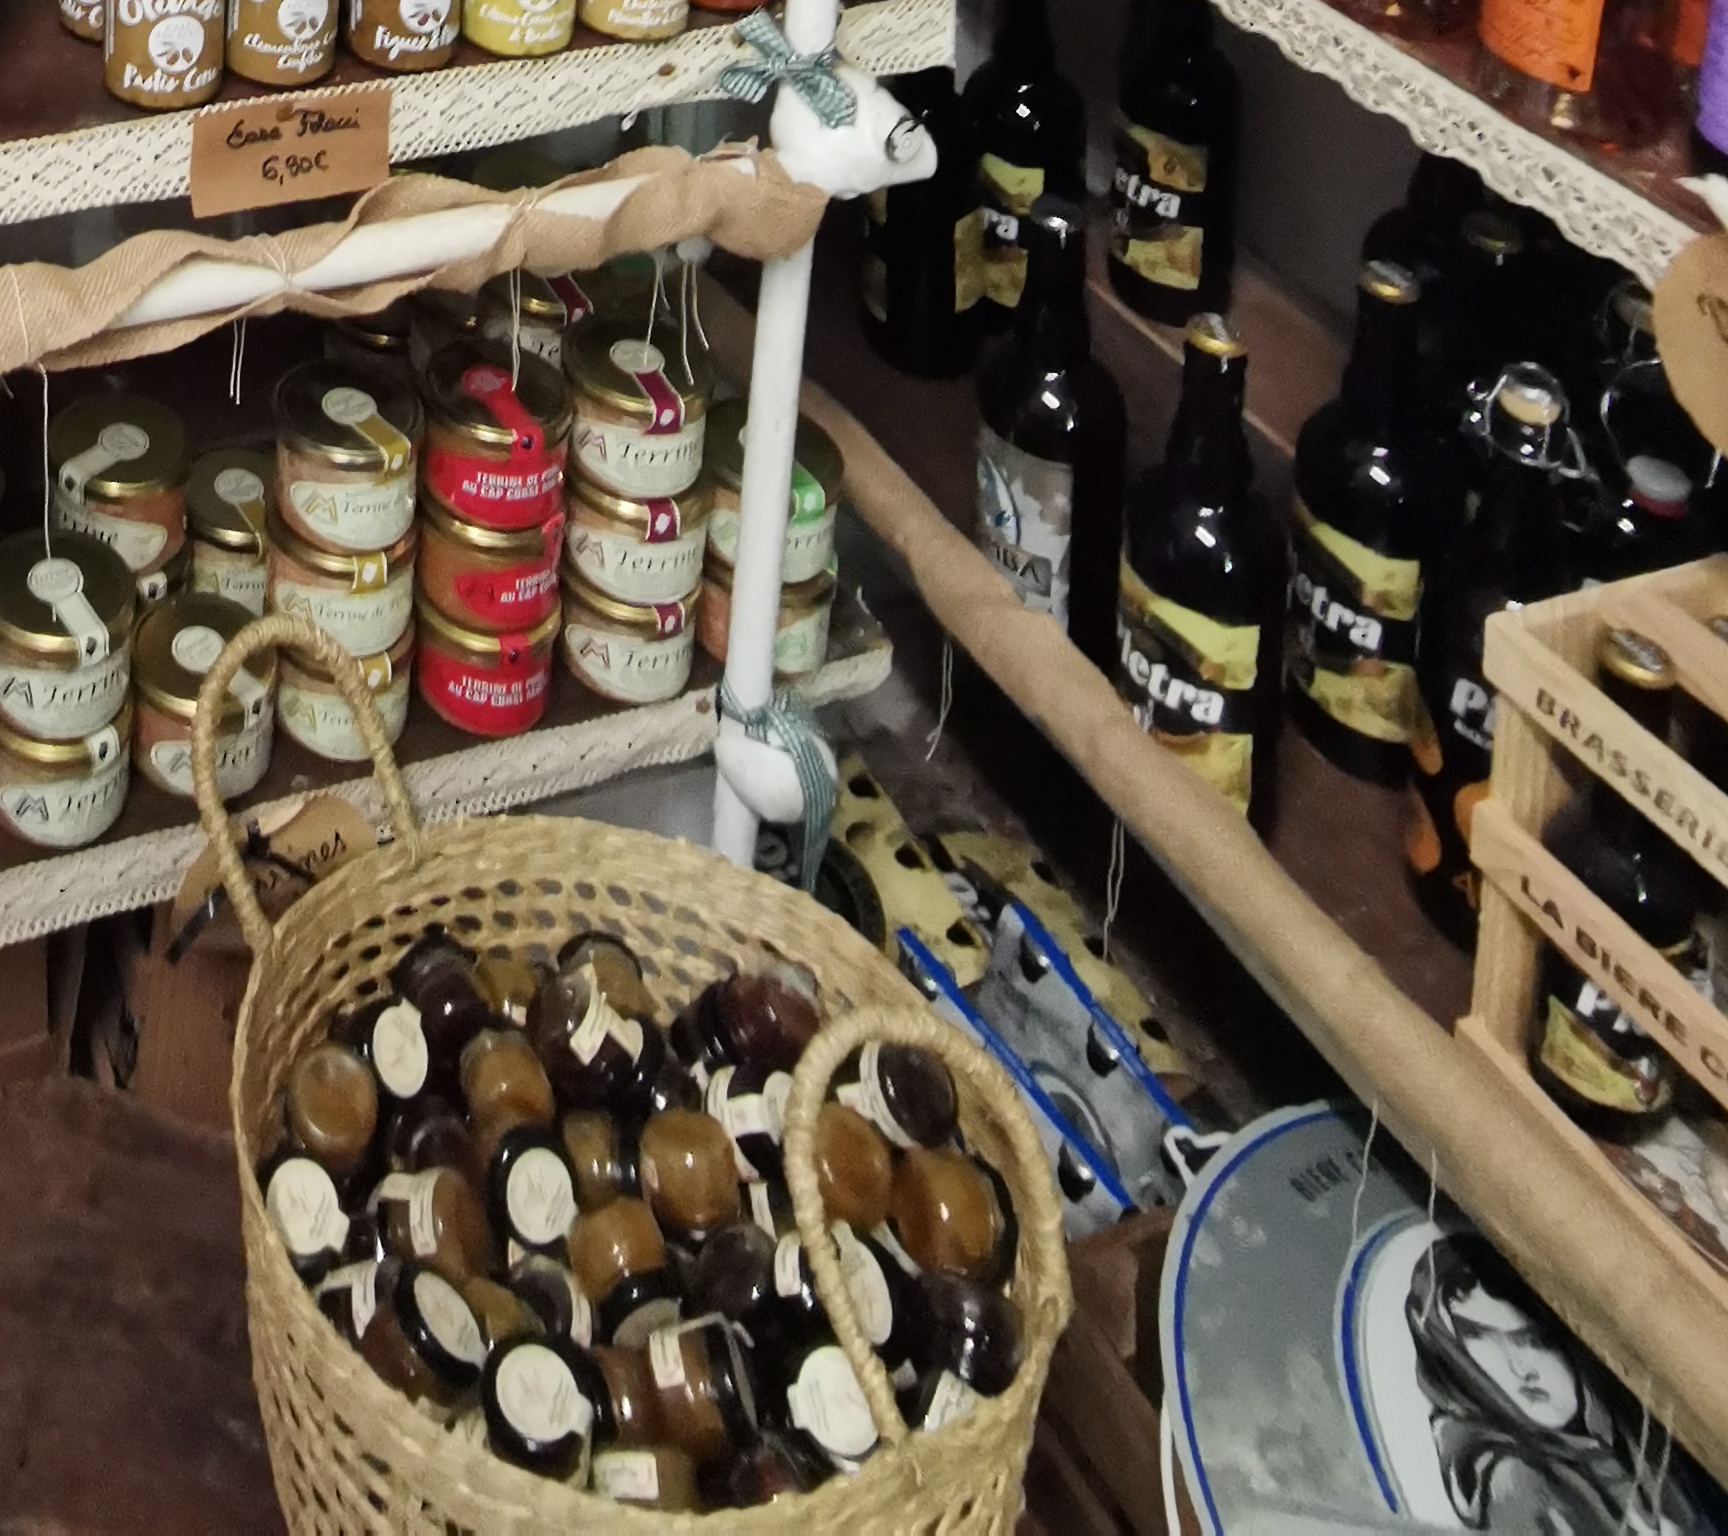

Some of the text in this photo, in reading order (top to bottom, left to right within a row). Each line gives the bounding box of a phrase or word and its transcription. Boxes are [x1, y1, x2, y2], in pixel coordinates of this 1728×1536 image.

[615, 431, 701, 473] Terrine
[613, 539, 700, 577] Terrine
[1518, 874, 1689, 1048] LA BIERE
